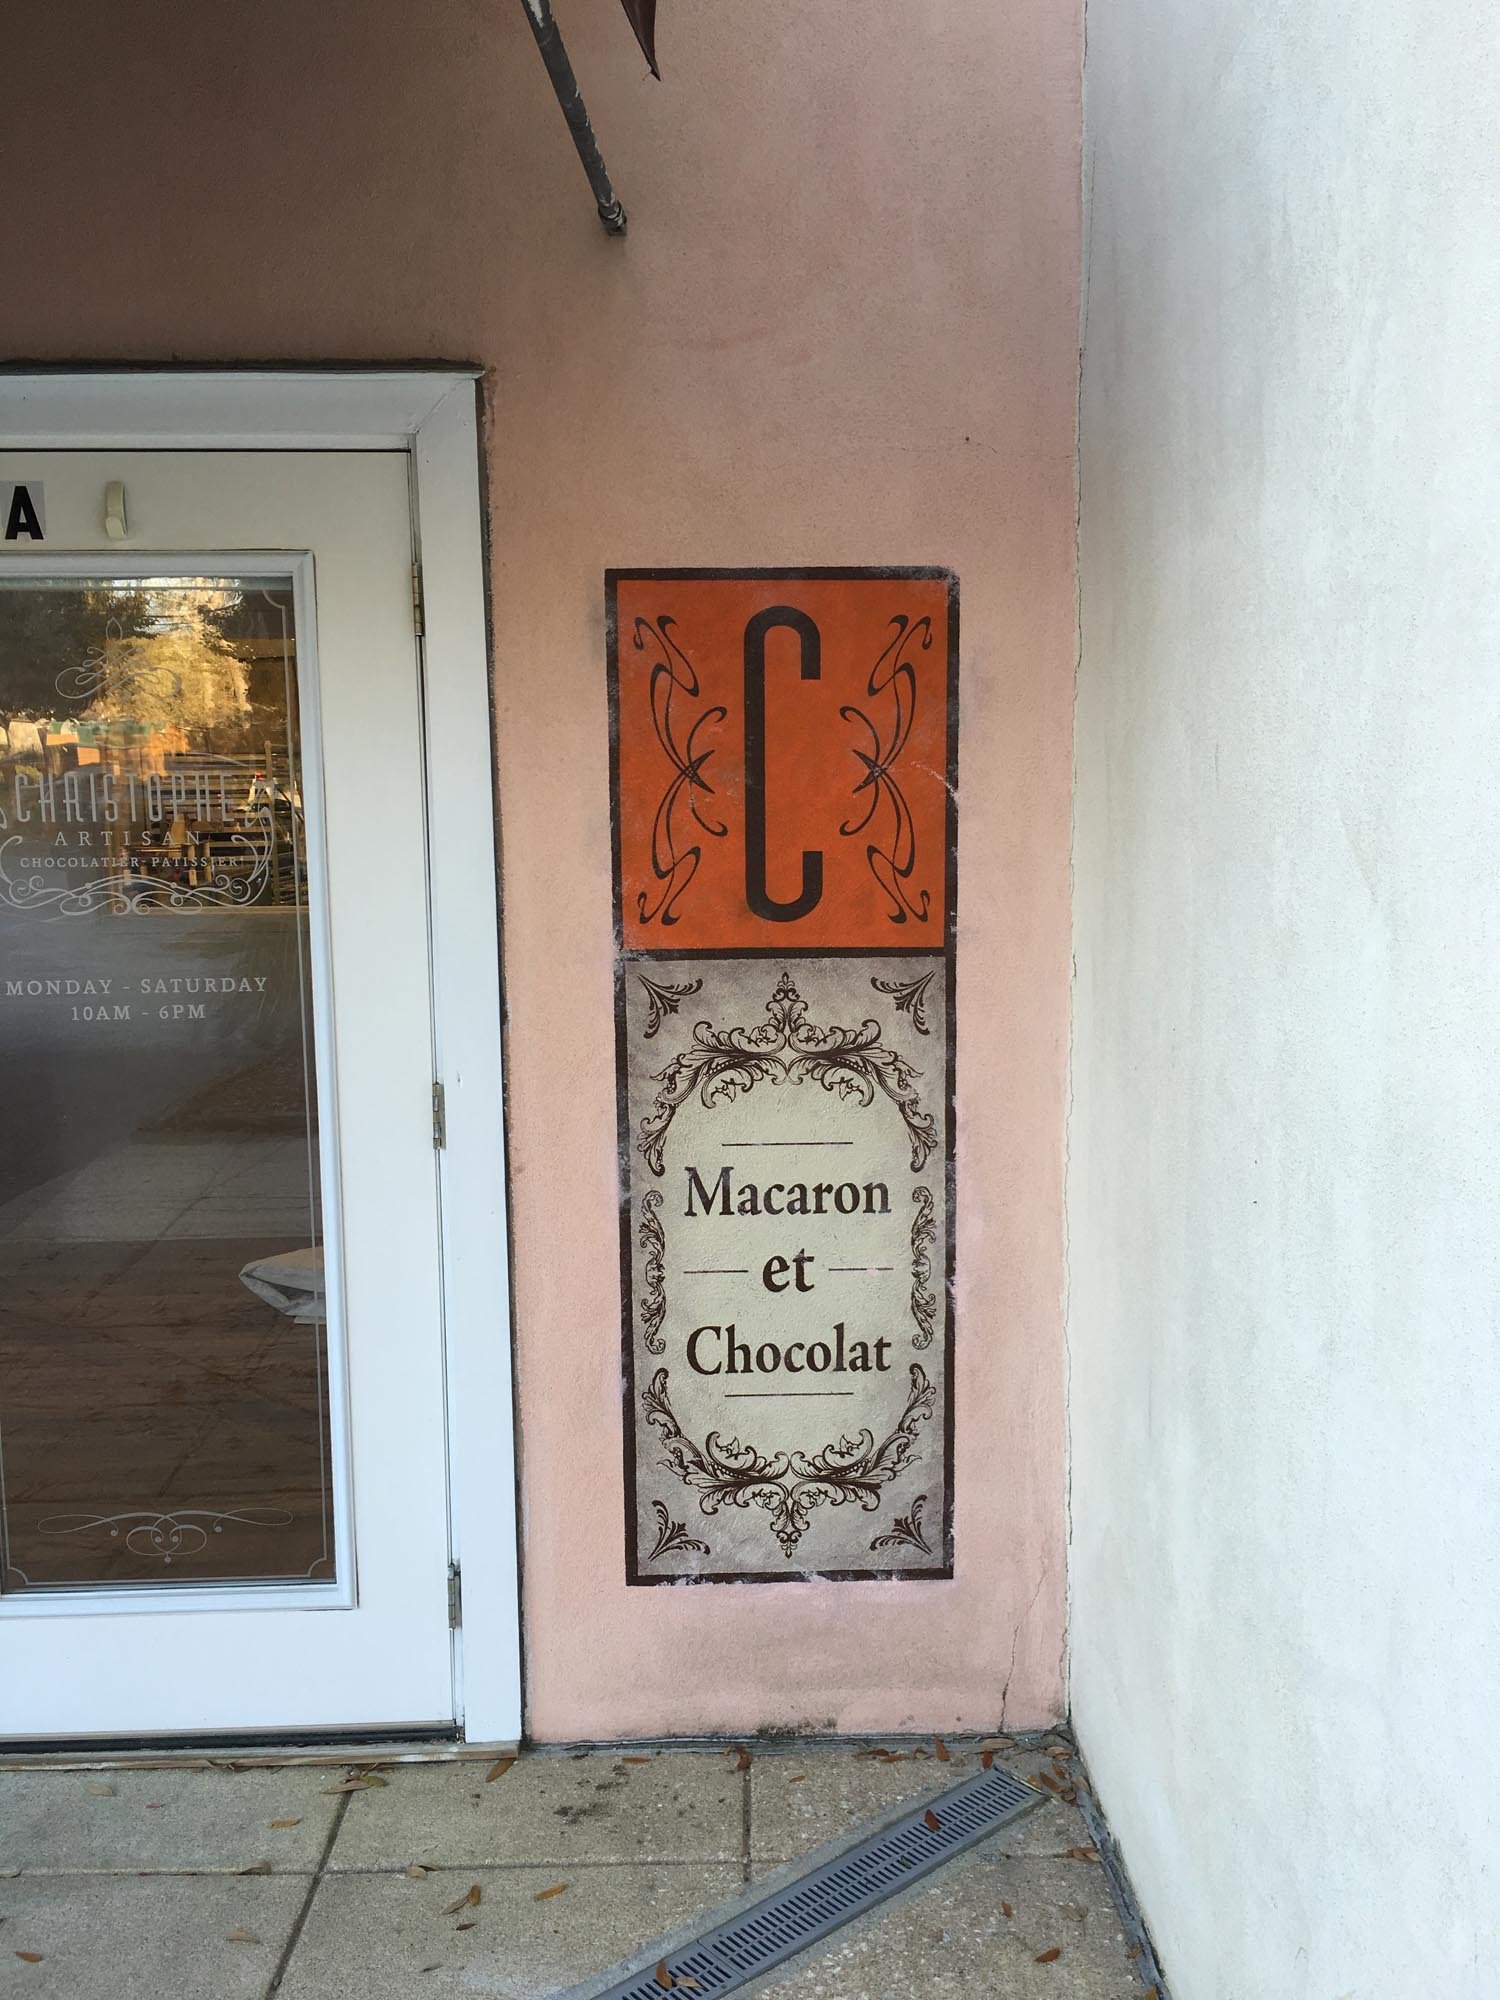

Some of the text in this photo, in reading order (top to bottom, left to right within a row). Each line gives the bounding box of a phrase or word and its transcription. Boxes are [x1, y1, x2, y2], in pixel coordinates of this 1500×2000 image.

[5, 485, 44, 540] A
[743, 605, 823, 922] C
[15, 773, 234, 823] CHRISTOPHE
[55, 831, 201, 846] ARTISAN
[6, 979, 112, 996] MONDAY
[140, 977, 268, 993] SATURDAY
[71, 1005, 131, 1021] 10AM
[159, 1004, 206, 1020] 6PM
[684, 1166, 892, 1216] Macaron
[762, 1248, 815, 1293] et
[686, 1322, 892, 1375] Chocolat
